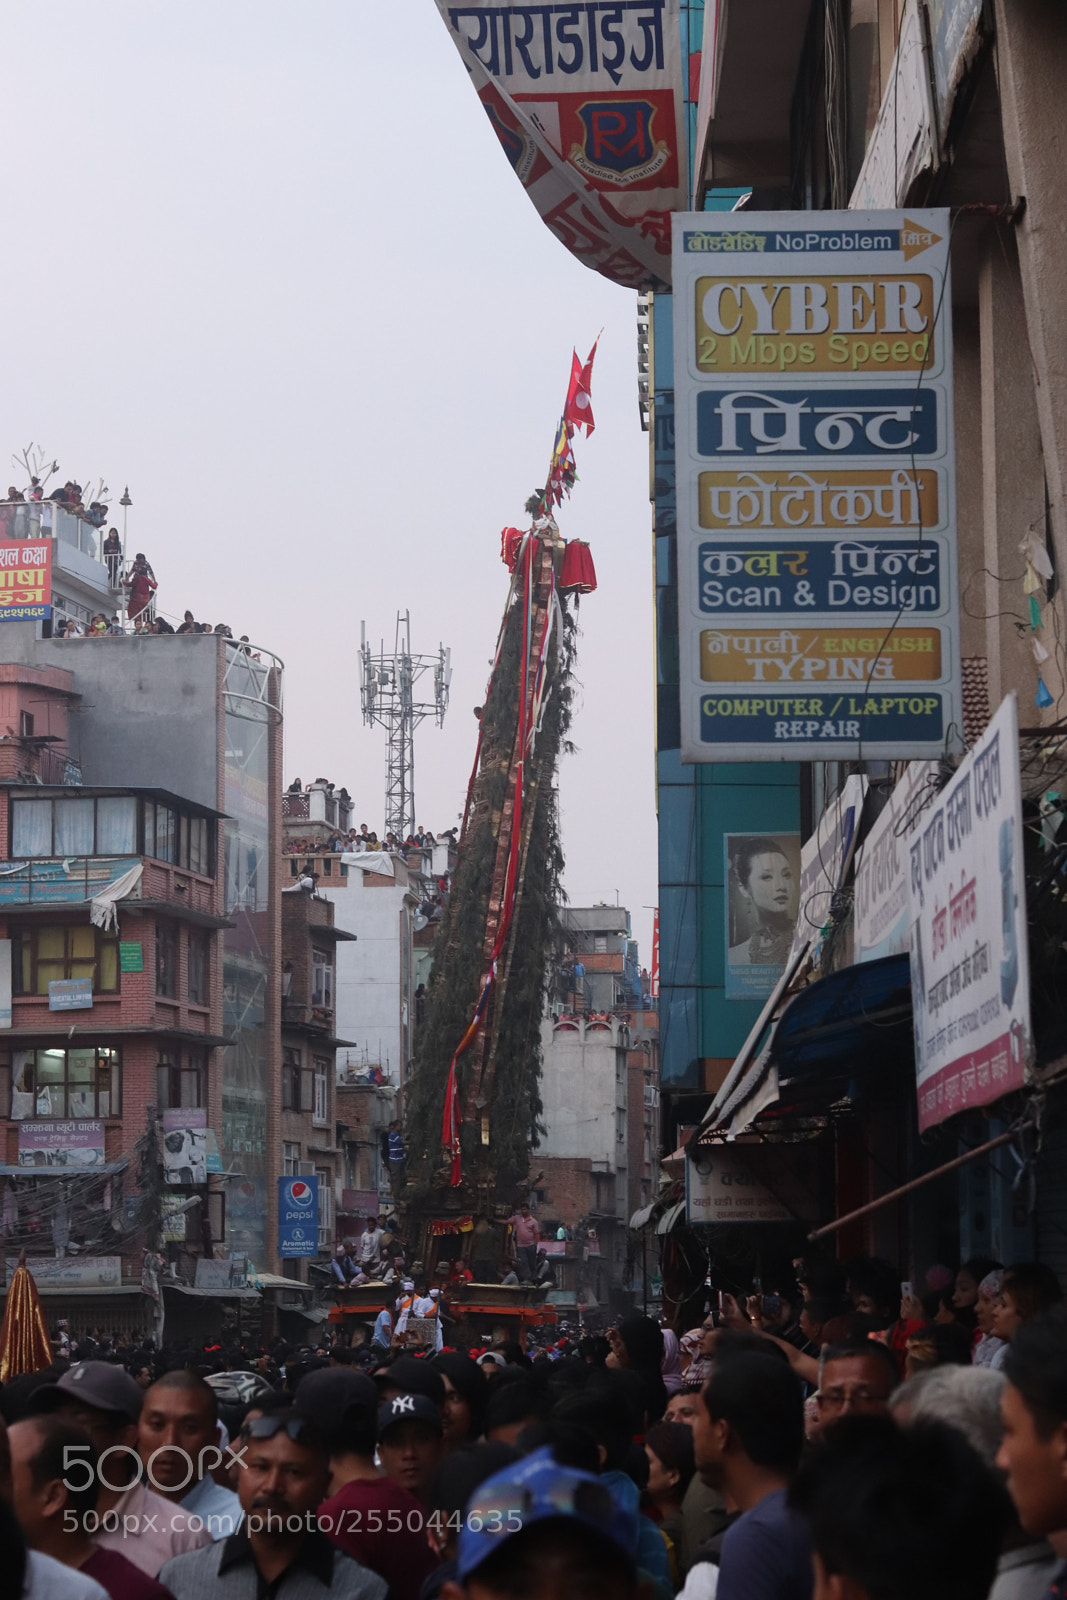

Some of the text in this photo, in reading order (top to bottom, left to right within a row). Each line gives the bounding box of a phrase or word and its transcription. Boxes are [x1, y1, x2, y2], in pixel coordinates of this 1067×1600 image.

[576, 157, 664, 180] Paradise Institute
[775, 233, 892, 251] NoProblem
[702, 281, 928, 336] CYBER
[698, 334, 930, 371] 2 Mbps Speed
[714, 391, 923, 454] प्रिन्ट
[709, 469, 925, 526] फोटोकपी
[22, 546, 48, 566] कक्षा
[702, 541, 938, 578] कलर प्रिन्ट
[0, 568, 47, 587] ाषा
[703, 580, 937, 611] Scan & Design
[824, 638, 934, 653] ENGLISH
[745, 655, 896, 681] TYPING
[703, 696, 939, 718] COMPUTER / LAPTOP
[774, 720, 861, 738] REPAIR
[285, 1210, 313, 1221] pepsi
[282, 1239, 315, 1247] Aromatic
[392, 1395, 415, 1415] NY
